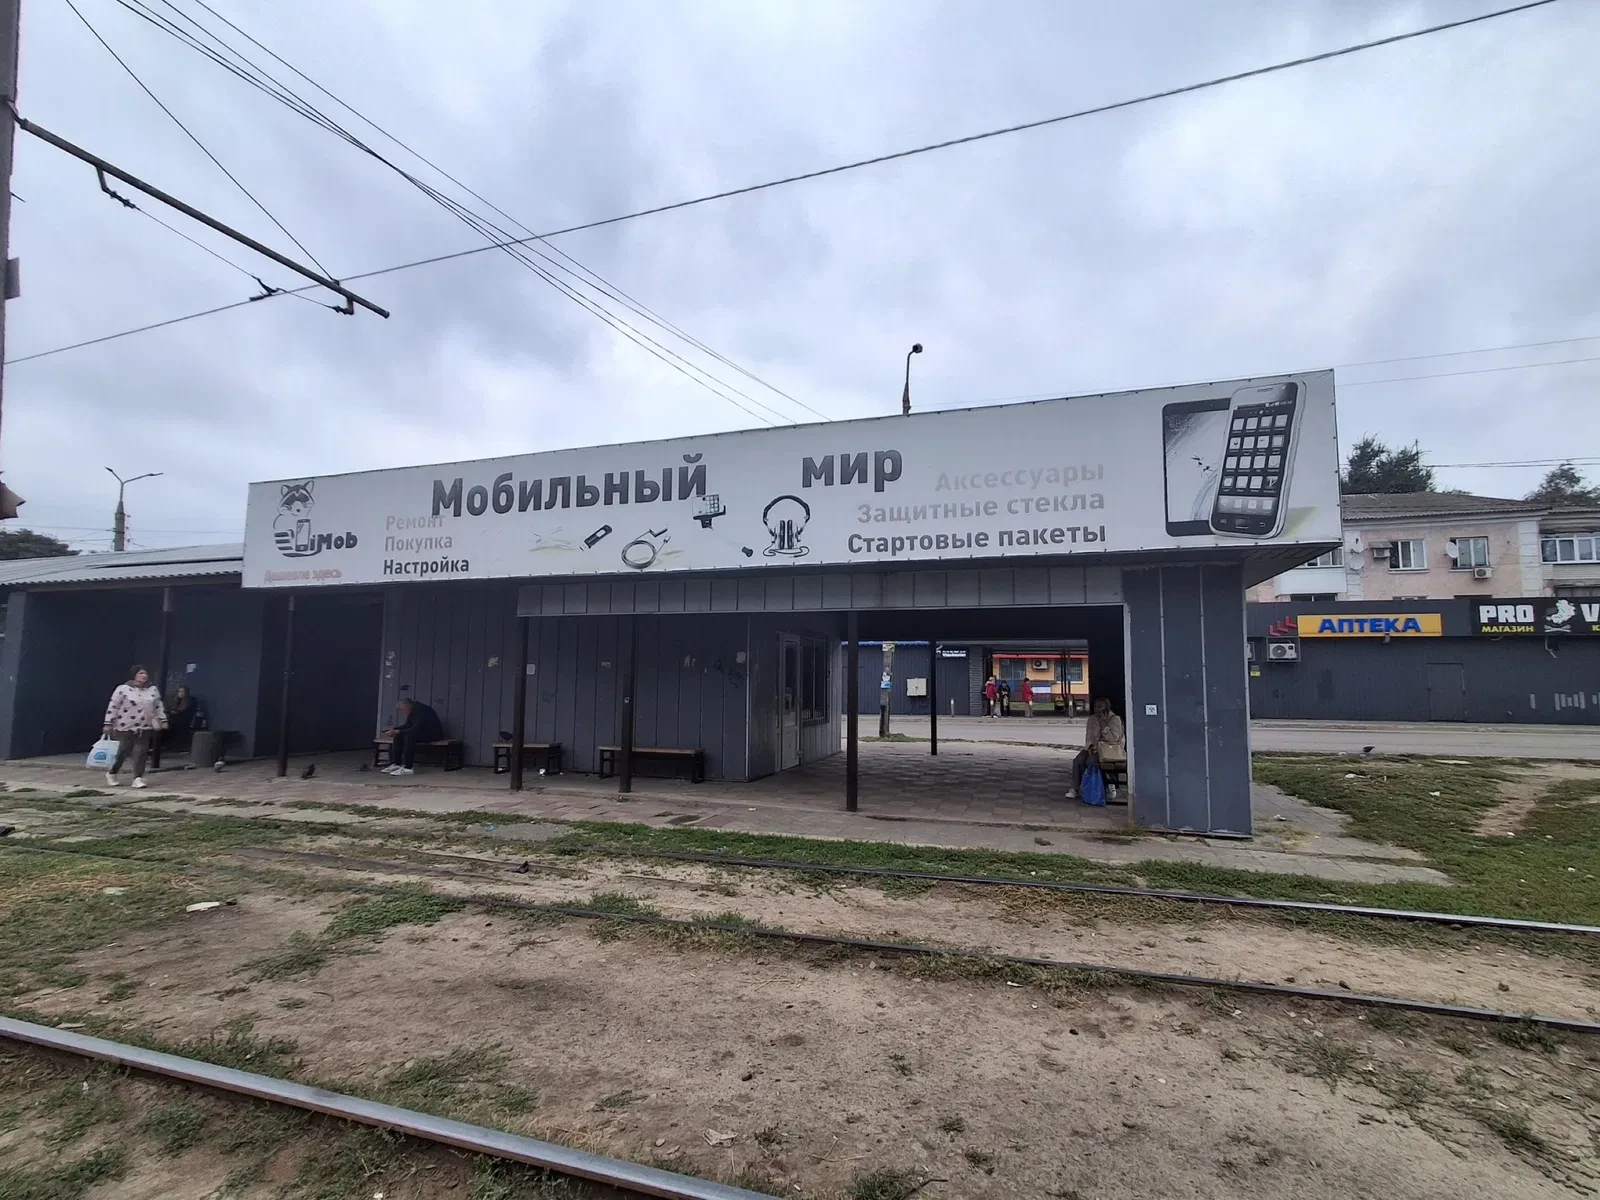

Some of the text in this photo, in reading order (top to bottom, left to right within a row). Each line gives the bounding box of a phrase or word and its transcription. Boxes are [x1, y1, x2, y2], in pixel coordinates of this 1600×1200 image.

[431, 449, 903, 517] Мобильный мир
[935, 463, 1105, 493] Аксессуары
[857, 492, 1105, 525] Защитные стекла
[385, 515, 446, 531] Ремонт
[385, 536, 453, 554] Покупка
[848, 523, 1106, 556] Стартовые пакеты
[383, 556, 470, 577] Настройка
[1479, 605, 1534, 623] PRO
[1319, 617, 1422, 633] АПТЕКА
[1481, 625, 1534, 633] МАГАЗИН
